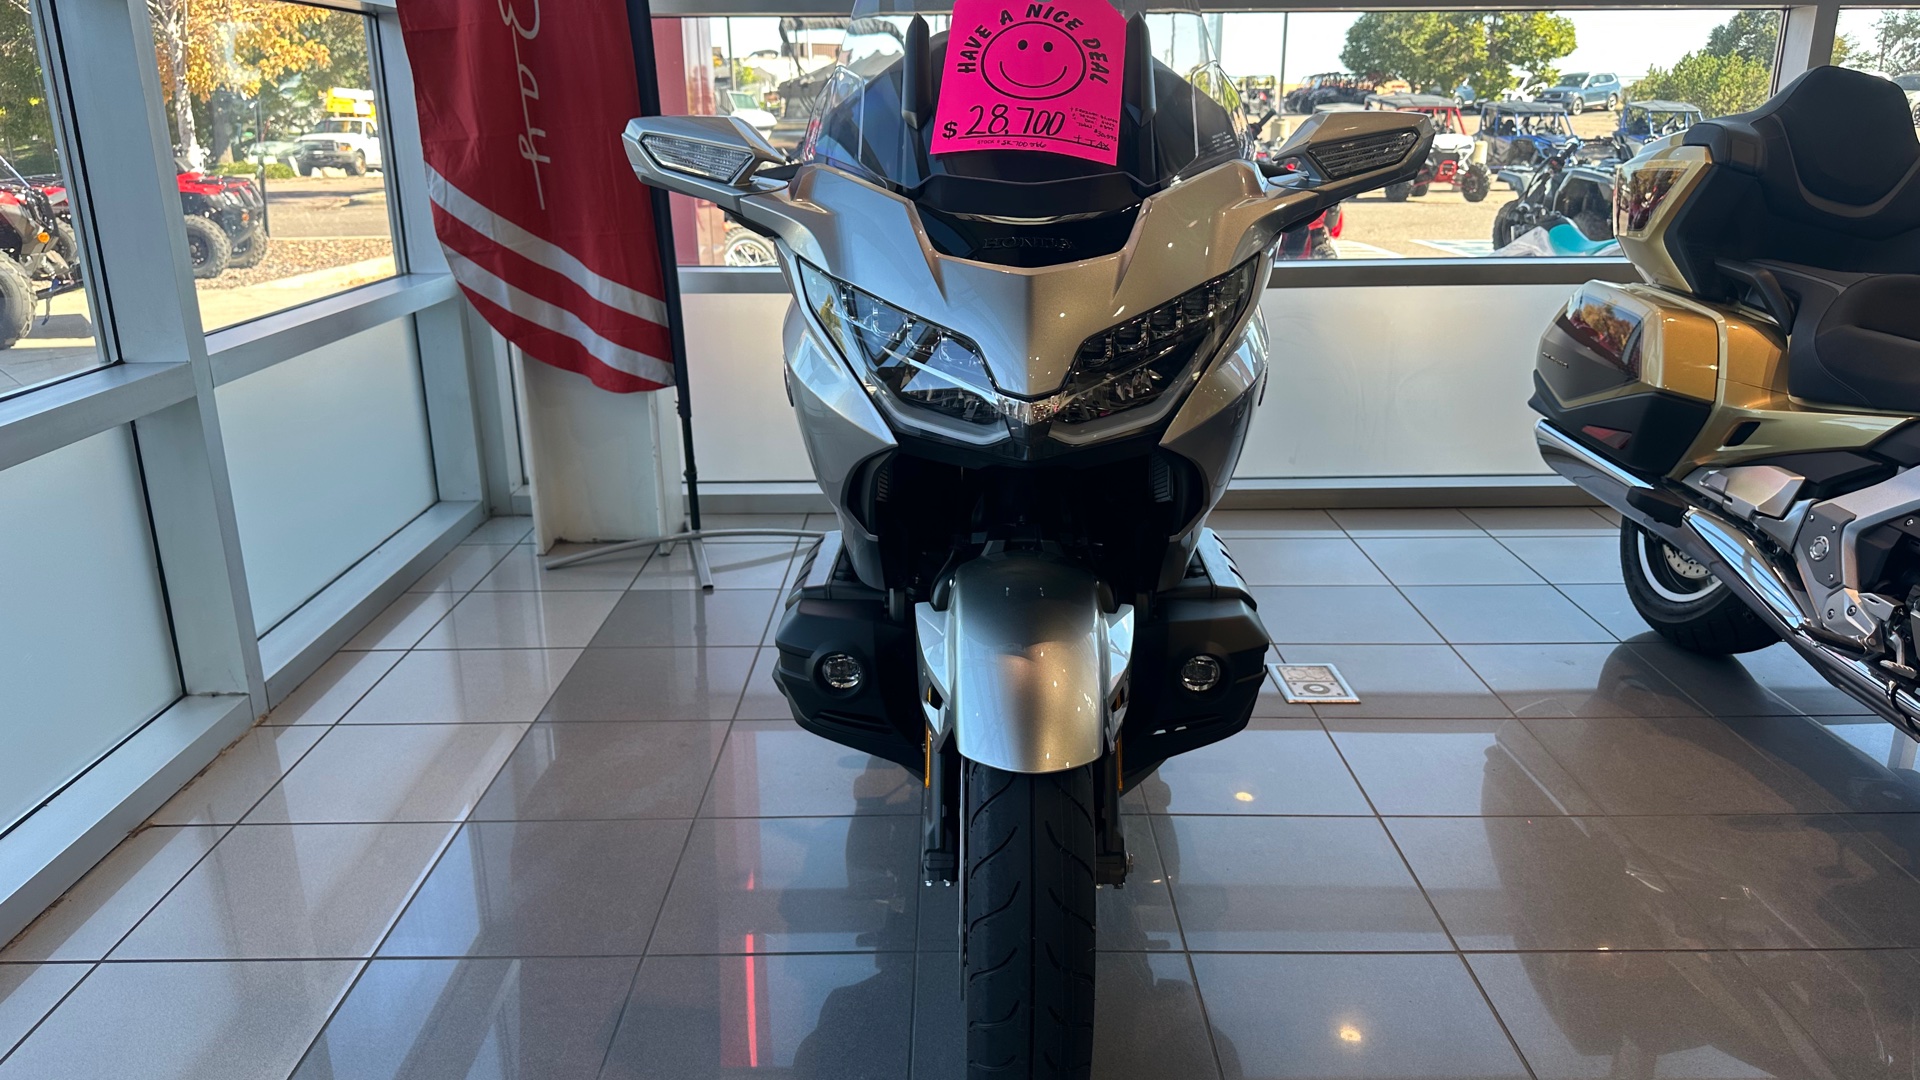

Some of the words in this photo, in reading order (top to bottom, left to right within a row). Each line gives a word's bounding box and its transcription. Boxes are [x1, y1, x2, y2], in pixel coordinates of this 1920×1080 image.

[957, 24, 992, 73] HAVE
[1000, 10, 1014, 25] A
[1026, 4, 1084, 31] NICE
[1082, 38, 1109, 84] DEAL
[982, 236, 1076, 250] HONDA
